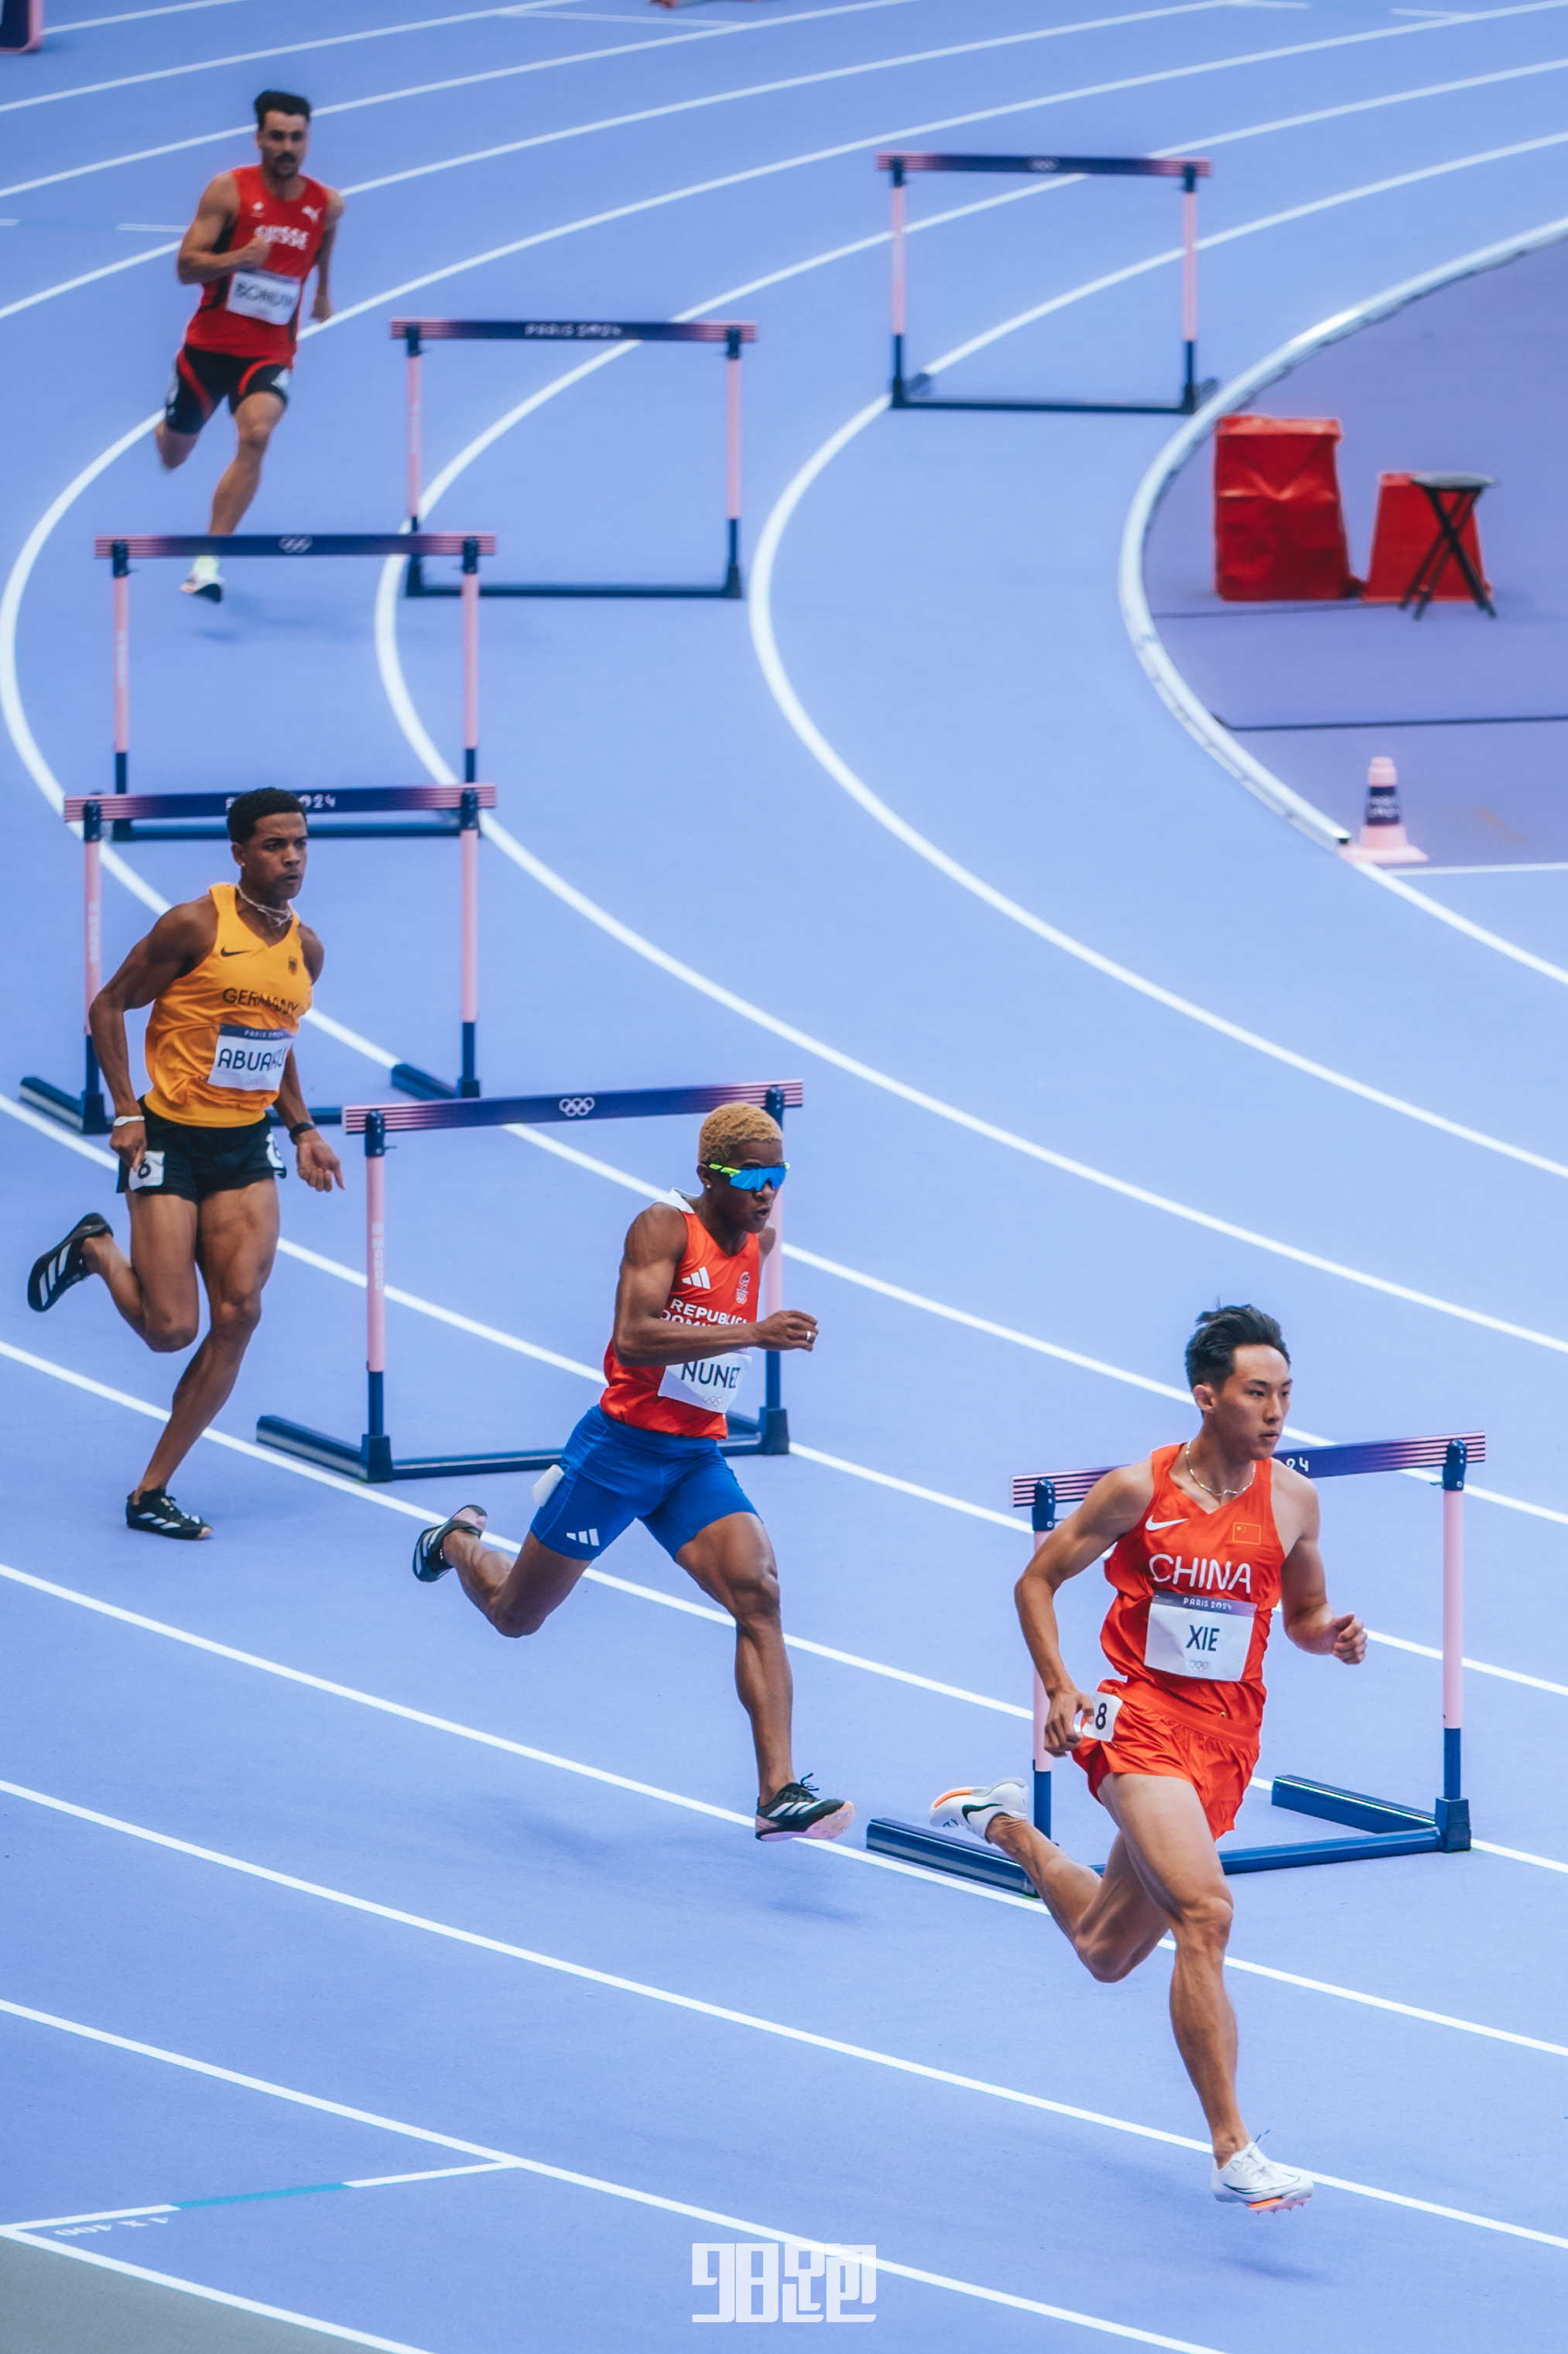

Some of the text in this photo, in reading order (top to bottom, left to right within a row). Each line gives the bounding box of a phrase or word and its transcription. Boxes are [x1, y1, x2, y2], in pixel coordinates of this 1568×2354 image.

[298, 793, 336, 808] 024
[222, 988, 300, 1016] GERMANY
[1149, 1553, 1251, 1595] CHINA
[1183, 1597, 1232, 1611] PARIS 2024
[1185, 1624, 1221, 1652] XIE
[1095, 1702, 1108, 1731] 8
